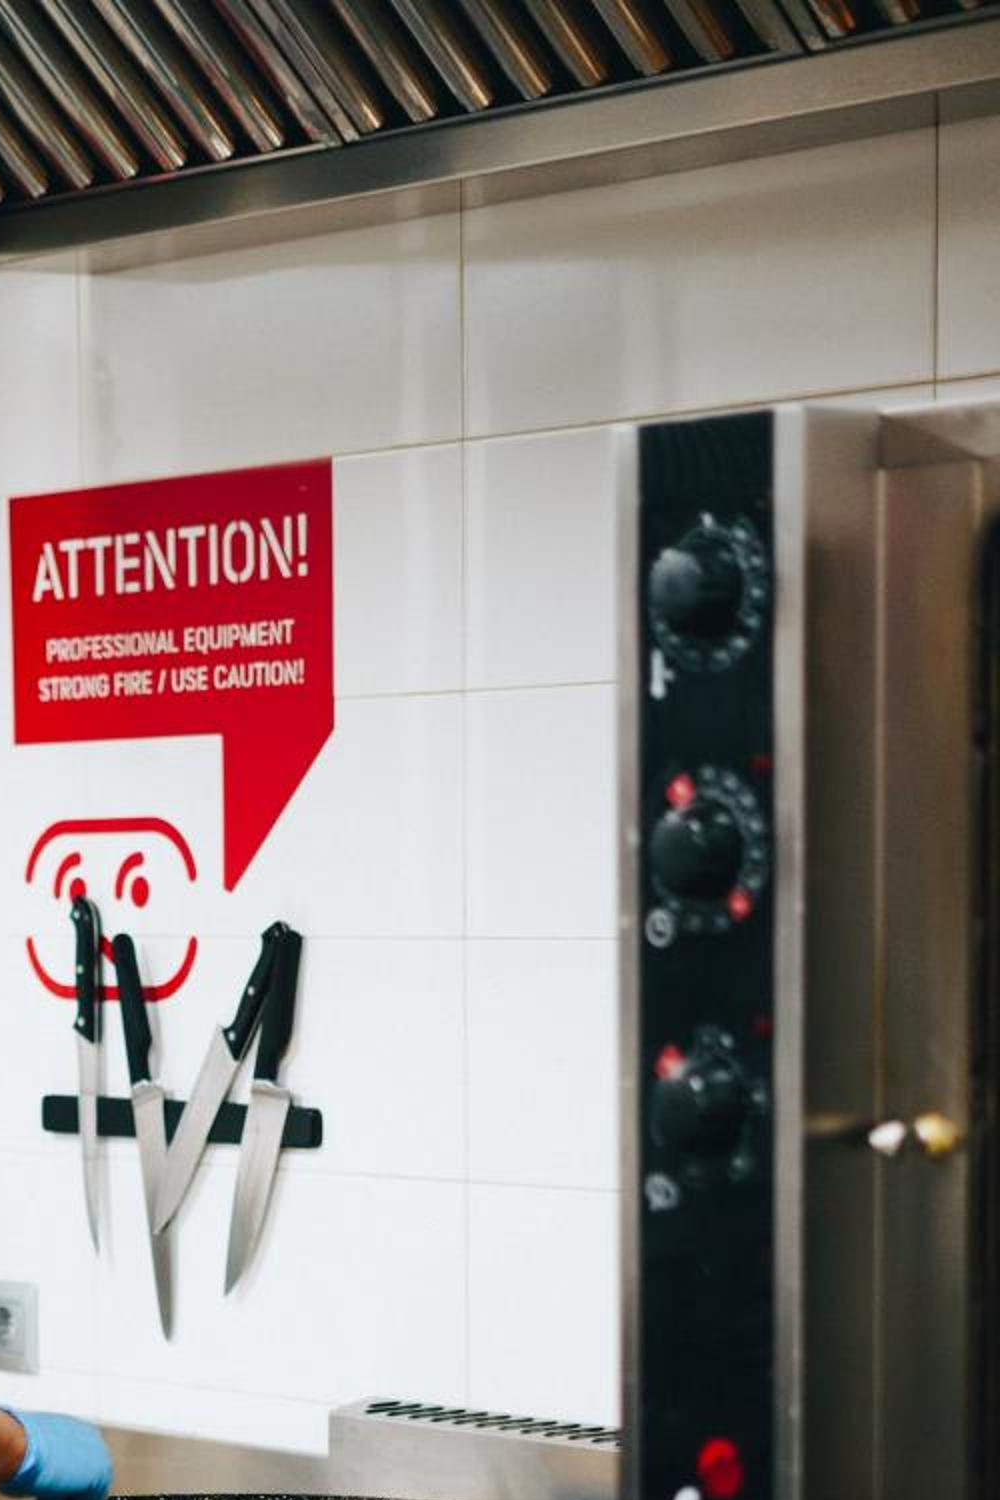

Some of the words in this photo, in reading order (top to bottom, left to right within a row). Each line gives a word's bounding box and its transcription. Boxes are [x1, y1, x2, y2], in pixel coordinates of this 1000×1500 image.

[32, 513, 308, 603] ATTENTION!
[45, 631, 179, 664] PROFESSIONAL
[184, 618, 295, 655] EQUIPMENT
[38, 674, 110, 703] STRONG
[114, 670, 153, 697] FIRE
[157, 671, 168, 694] /
[171, 665, 209, 694] USE
[213, 658, 305, 690] CAUTION!
